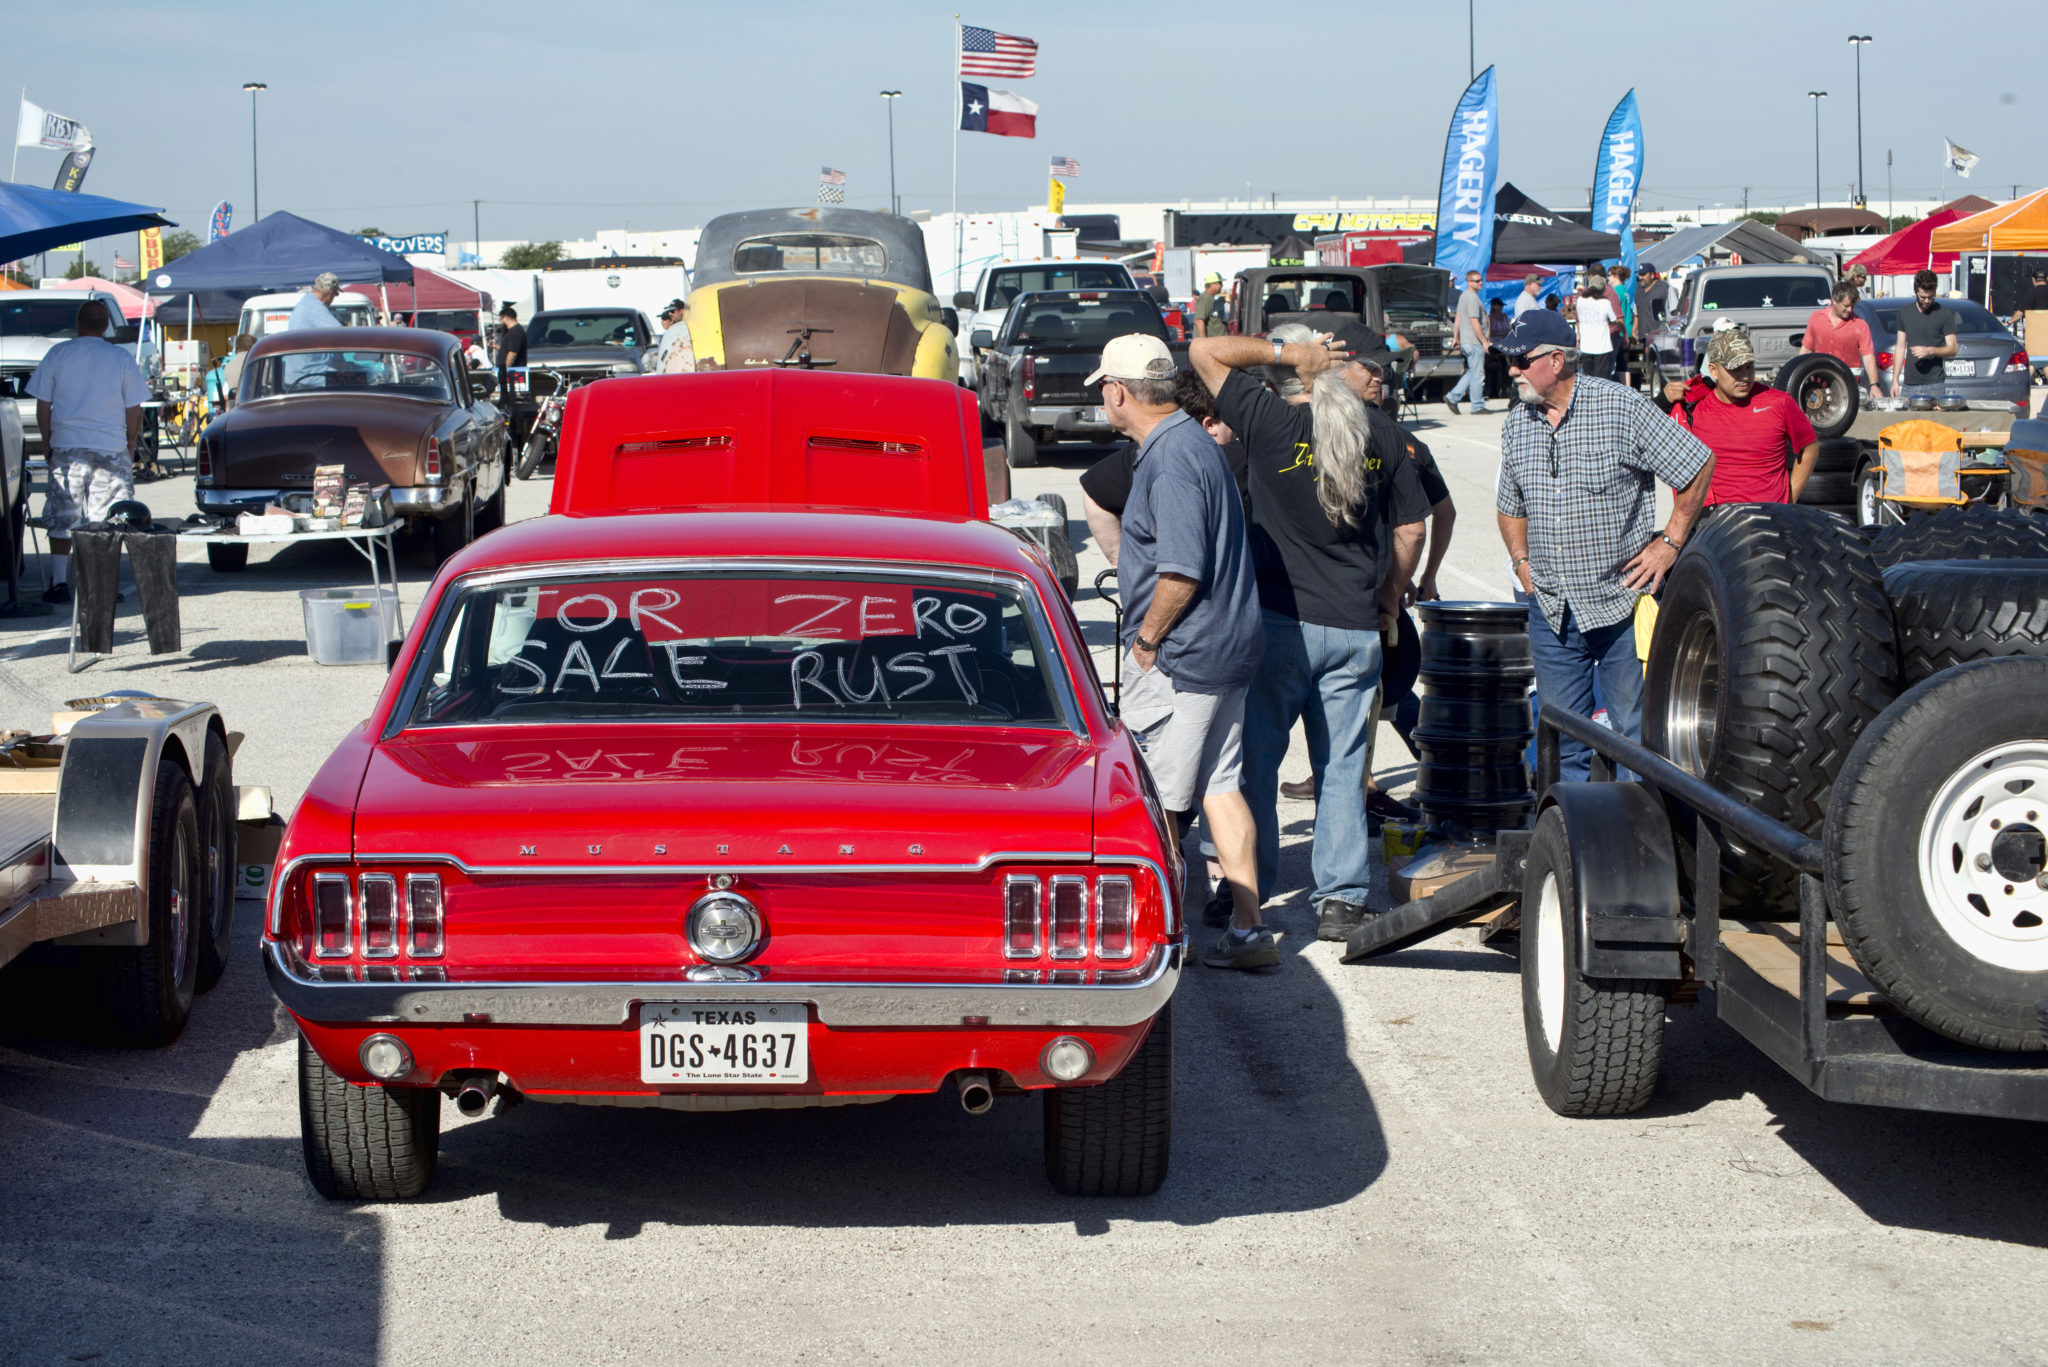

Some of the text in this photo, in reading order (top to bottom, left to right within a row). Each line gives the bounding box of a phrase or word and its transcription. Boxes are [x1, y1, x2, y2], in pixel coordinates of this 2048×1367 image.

[1453, 110, 1488, 247] HAGERTY
[1494, 212, 1553, 226] AGERTY
[378, 236, 443, 253] COVERS
[500, 588, 683, 635] FOR
[775, 595, 987, 639] ZERO
[497, 637, 728, 693] SALE
[791, 644, 978, 710] RUST
[519, 843, 925, 857] MUSTANG
[692, 1011, 757, 1025] TEXAS
